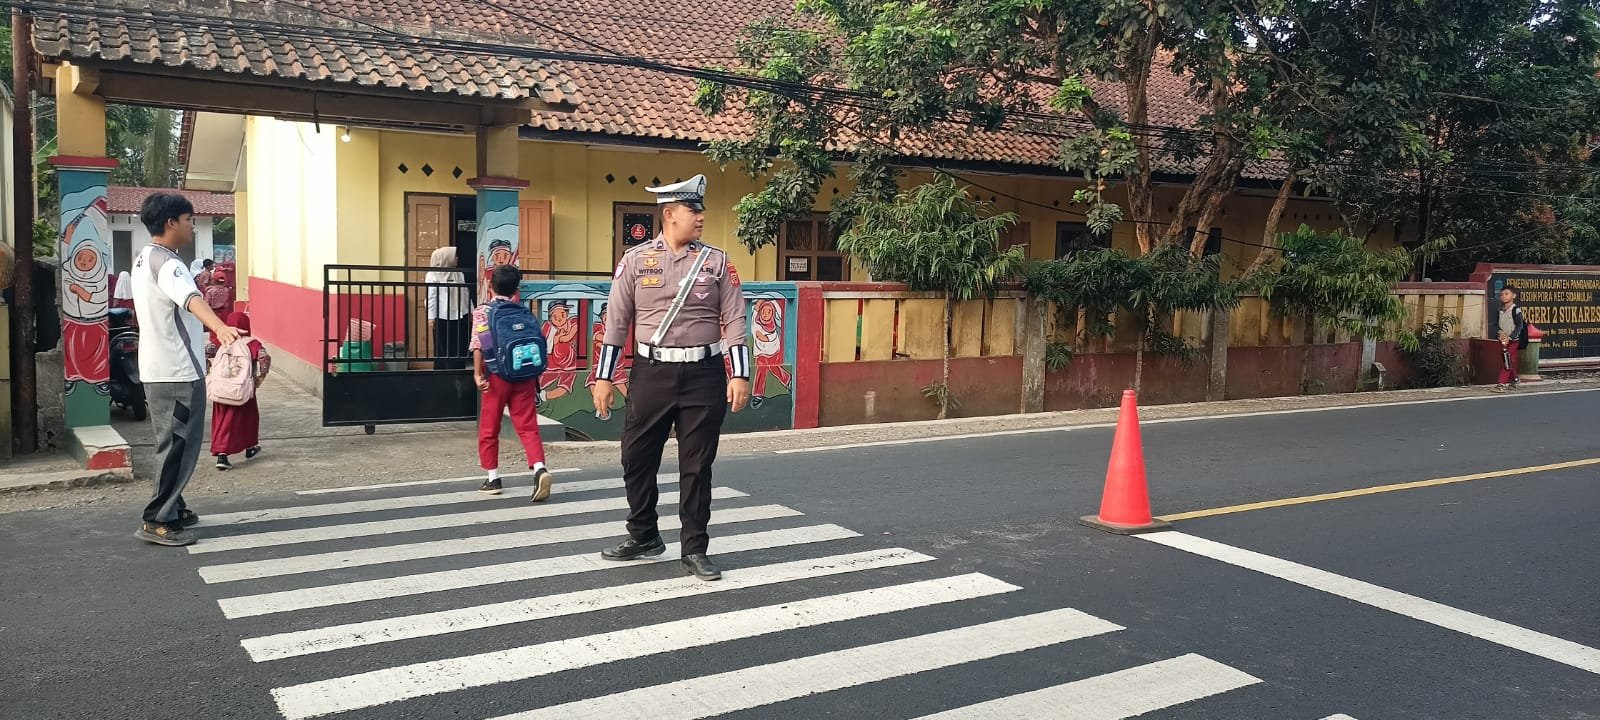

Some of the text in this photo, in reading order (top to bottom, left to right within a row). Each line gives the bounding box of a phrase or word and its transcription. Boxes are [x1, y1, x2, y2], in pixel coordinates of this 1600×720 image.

[1506, 278, 1600, 290] PEMERINTAH KABUPATEN PANGANDAR
[1552, 306, 1558, 324] 2
